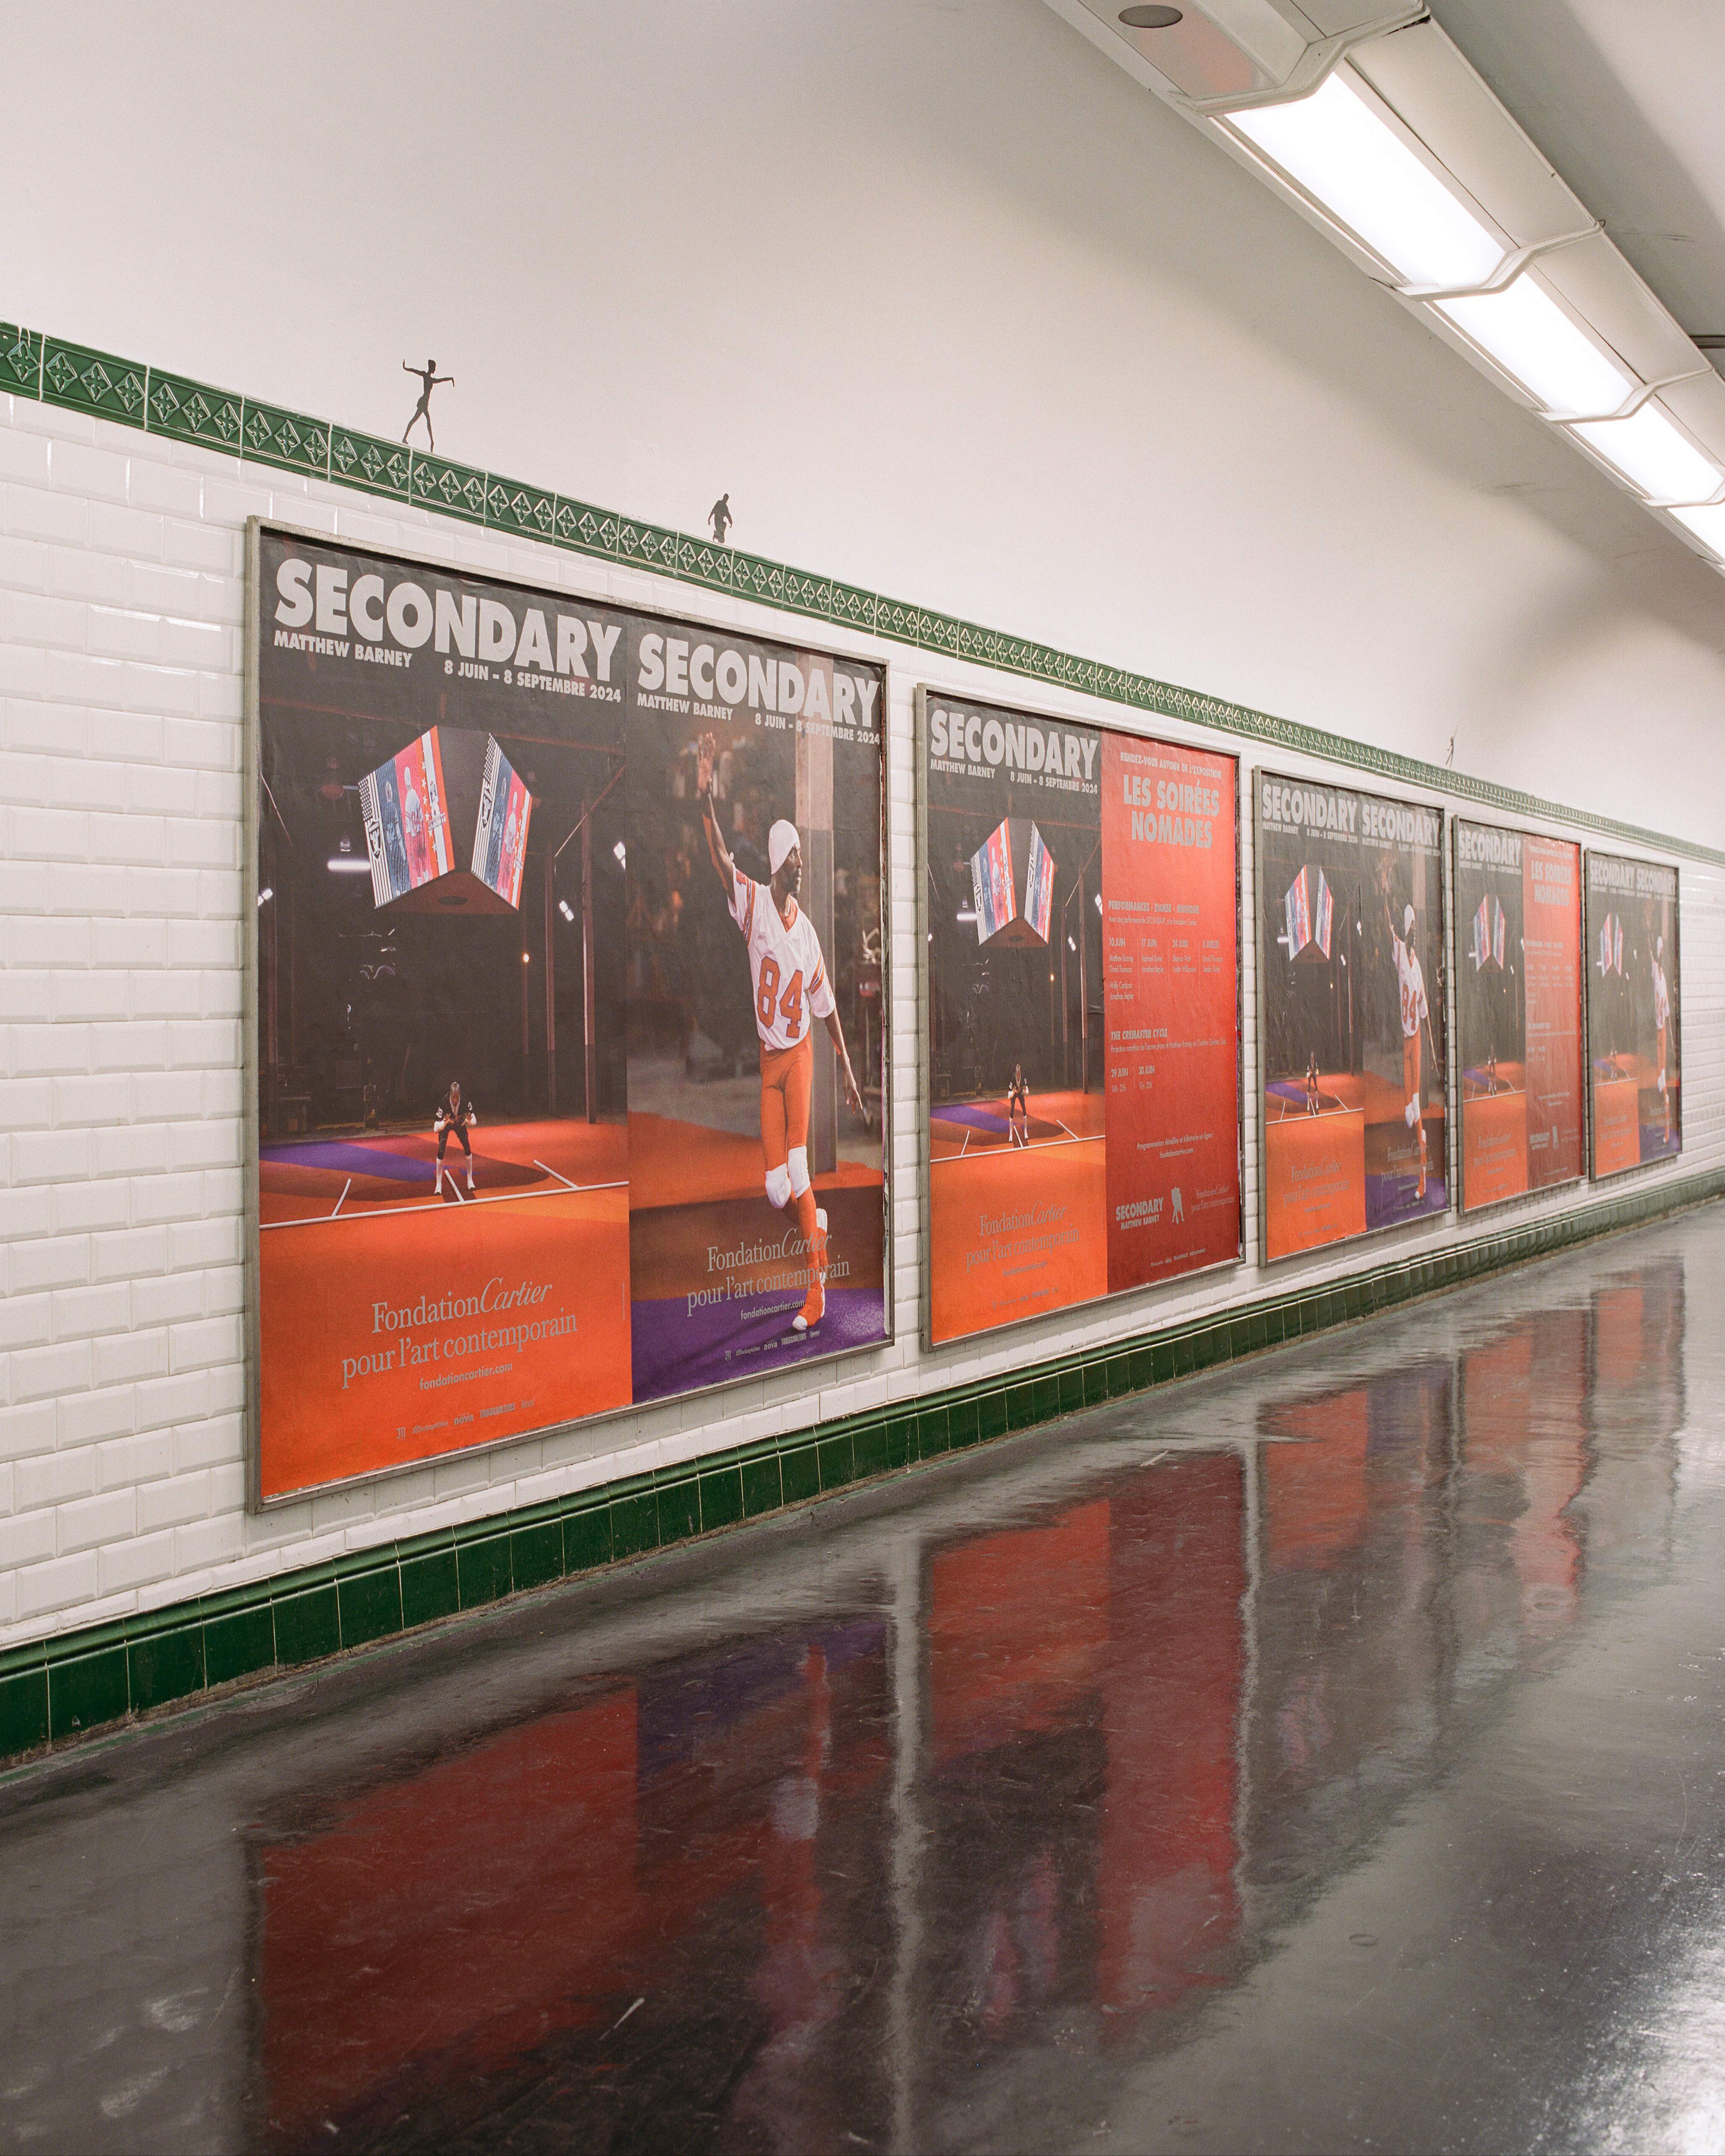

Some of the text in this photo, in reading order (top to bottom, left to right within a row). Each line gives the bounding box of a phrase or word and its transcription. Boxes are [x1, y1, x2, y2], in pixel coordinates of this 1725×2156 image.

[275, 558, 622, 681] SECONDARY
[274, 630, 412, 668] MATTHEW BARNEY
[444, 660, 453, 675] 8
[458, 662, 489, 680] JUIN
[504, 670, 512, 684] 8
[517, 671, 585, 697] SEPTEMBRE
[589, 685, 621, 703] 2024
[638, 634, 880, 728] SECONDARY
[637, 693, 733, 720] MATTHEW BARNEY
[755, 714, 761, 725] 8
[765, 715, 786, 730] JUIN
[796, 720, 803, 732] 8
[805, 722, 854, 741] SEPTEMBRE
[857, 732, 880, 745] 2024
[931, 709, 1098, 780] SECONDARY
[930, 759, 995, 779] MATTHEW BARNEY
[1120, 751, 1158, 768] RENDEZ-VOUS
[1159, 760, 1180, 771] AUTOUR
[1181, 764, 1188, 773] DE
[1010, 771, 1015, 782] 8
[1017, 772, 1032, 785] JUIN
[1039, 776, 1043, 786] 8
[1046, 777, 1079, 792] SEPTEMBRE
[1081, 784, 1097, 795] 2024
[1123, 774, 1220, 817] LES SOIRÉES
[1262, 784, 1357, 833] SECONDARY
[1131, 811, 1213, 849] NOMADES
[1362, 804, 1441, 847] SECONDARY
[1459, 829, 1521, 866] SECONDARY
[1108, 900, 1200, 914] PERFORMANCES DANSE MUSIQUE
[1116, 938, 1126, 947] JUIN
[1147, 939, 1157, 948] JUIN
[1179, 940, 1188, 948] JUIN
[757, 955, 803, 1039] 84
[1111, 1031, 1120, 1040] THE
[1122, 1029, 1151, 1040] CREMASTER
[1111, 1068, 1128, 1077] 29 JUIN
[1138, 1066, 1154, 1075] 30 JUIN
[1116, 1197, 1164, 1221] SECONDARY
[1120, 1214, 1160, 1230] MATTHEW BARNEY
[966, 1247, 992, 1273] pour
[1014, 1224, 1079, 1255] contemporain
[687, 1287, 724, 1317] pour
[757, 1255, 850, 1294] contemporain
[740, 1300, 805, 1320] fondationcartier.com
[342, 1348, 396, 1390] pour
[443, 1307, 578, 1358] contemporain
[419, 1362, 512, 1391] fondationcartier.com
